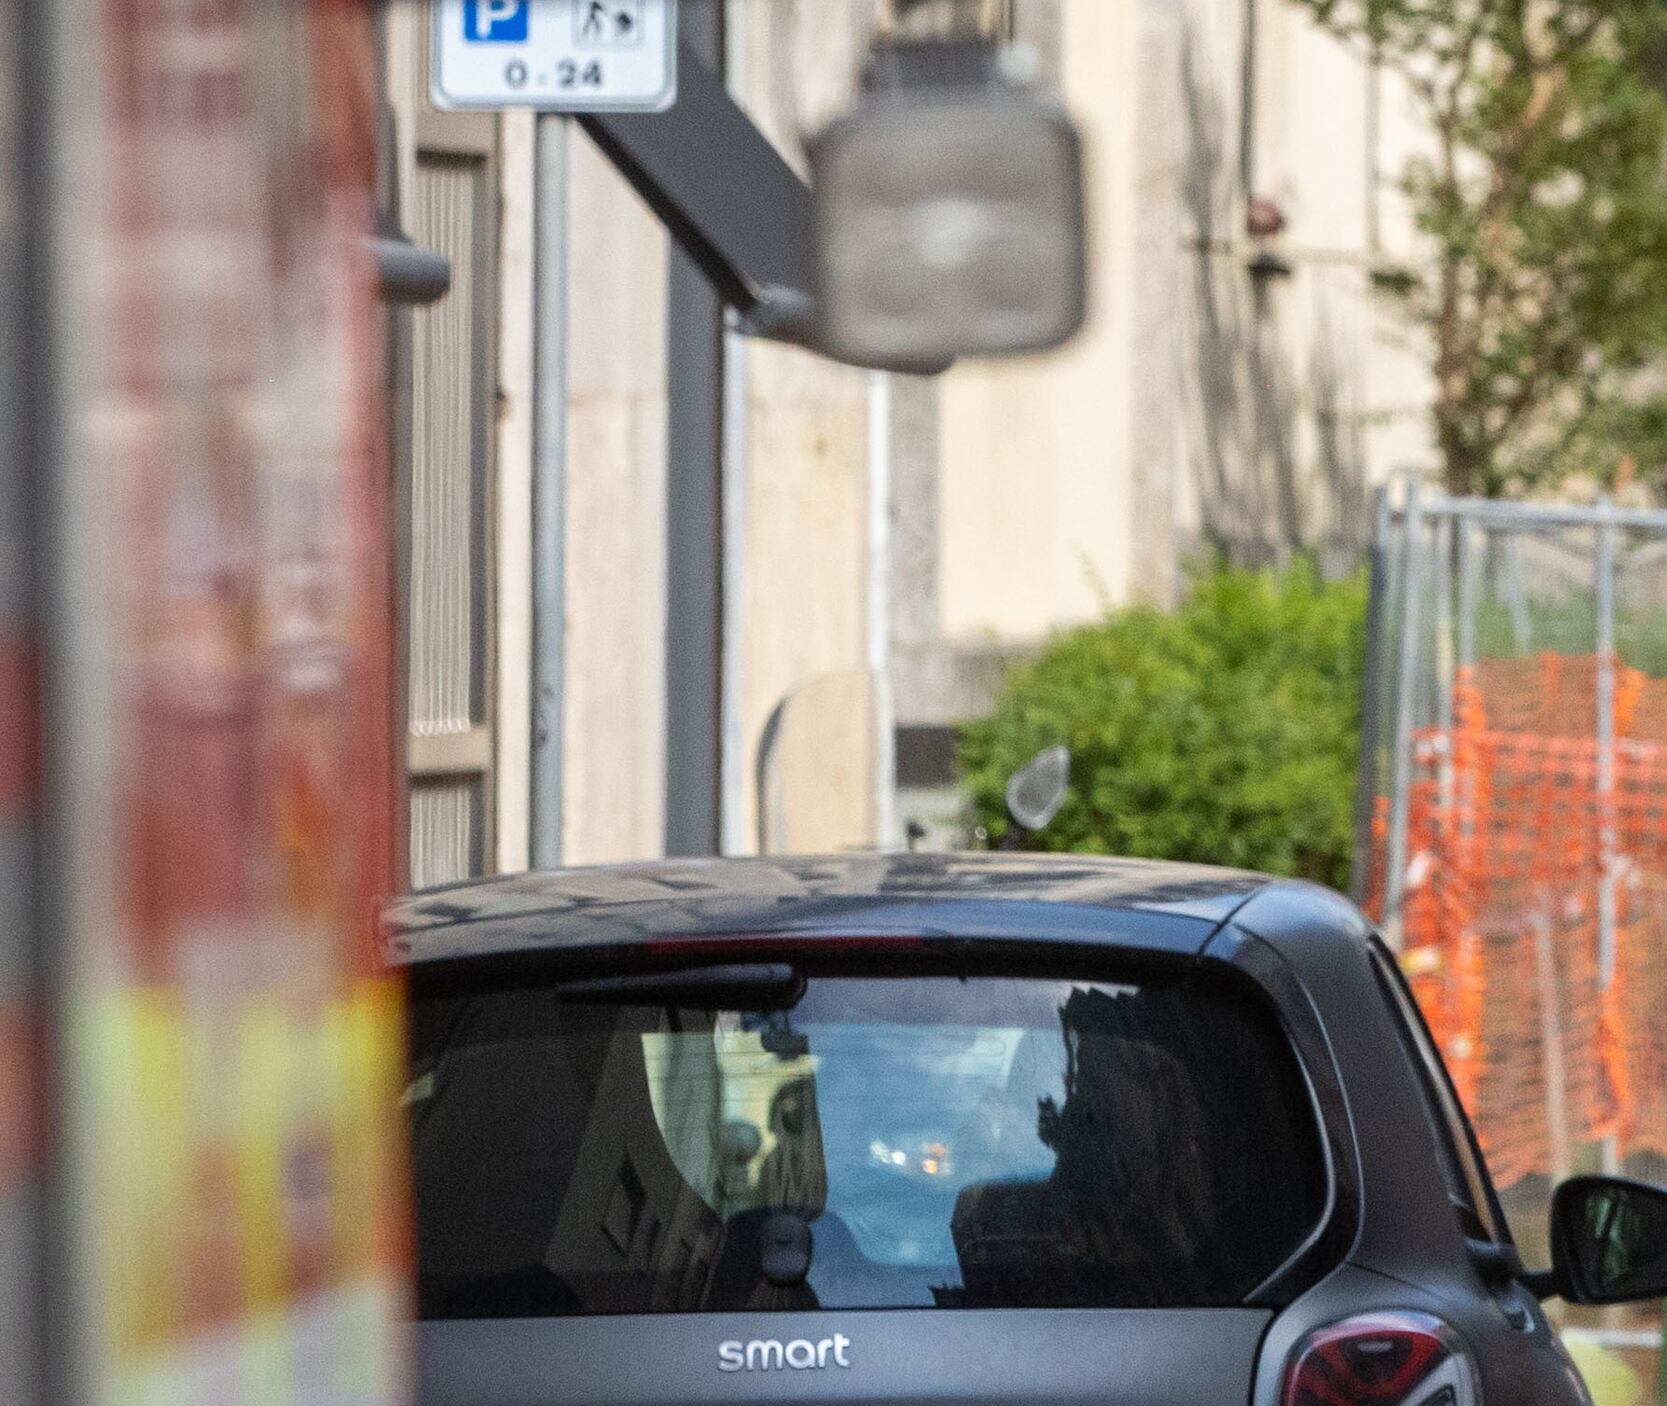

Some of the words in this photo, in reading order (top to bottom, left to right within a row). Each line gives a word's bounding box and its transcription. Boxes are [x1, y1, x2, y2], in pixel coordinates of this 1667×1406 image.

[505, 58, 528, 90] 0
[557, 58, 603, 90] 24
[717, 1333, 850, 1372] smart
